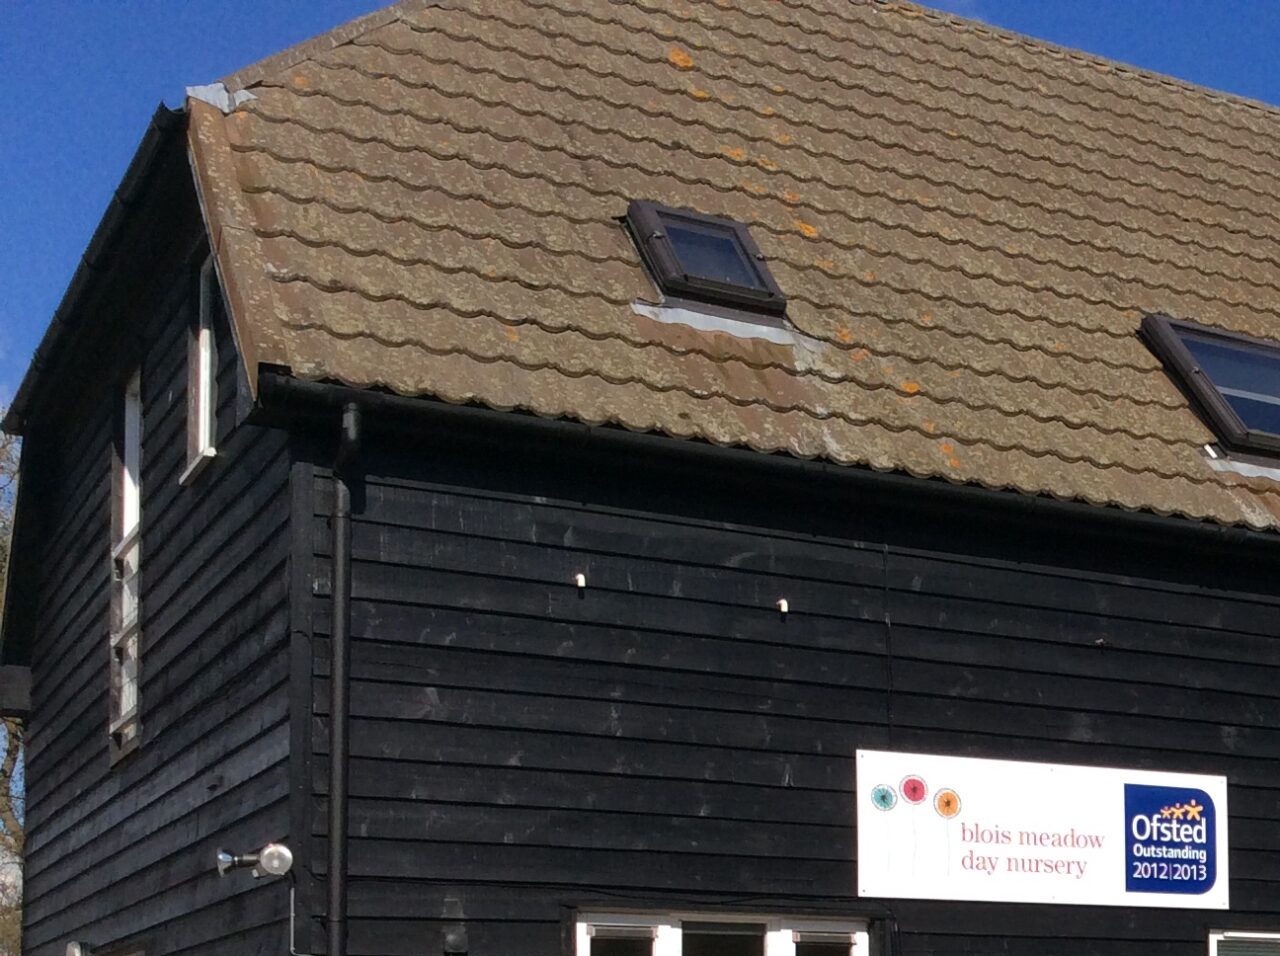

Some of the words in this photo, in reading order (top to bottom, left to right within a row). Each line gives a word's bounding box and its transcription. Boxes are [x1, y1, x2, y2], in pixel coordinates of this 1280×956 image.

[961, 822, 1012, 845] blois
[1017, 829, 1106, 850] meadow
[1131, 813, 1207, 845] Ofsted
[961, 849, 999, 876] day
[1006, 856, 1088, 880] nursery
[1132, 843, 1207, 864] Outstanding
